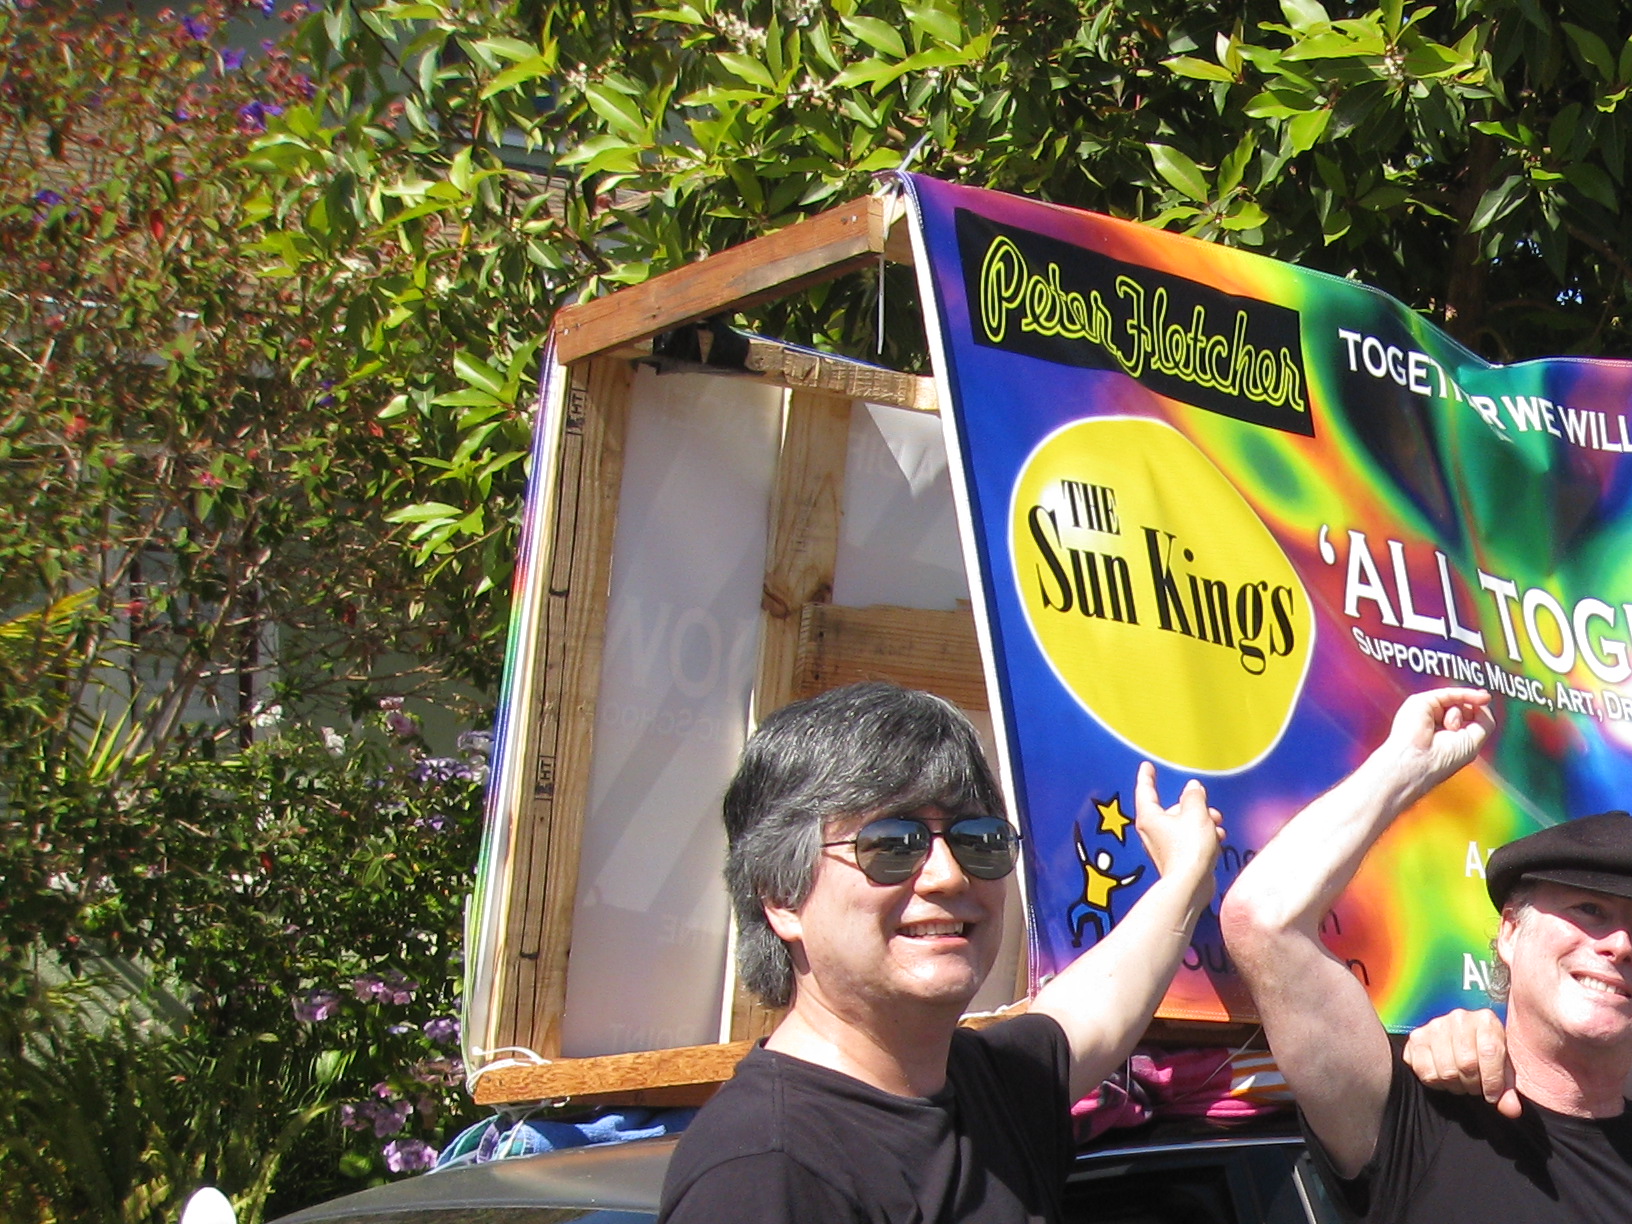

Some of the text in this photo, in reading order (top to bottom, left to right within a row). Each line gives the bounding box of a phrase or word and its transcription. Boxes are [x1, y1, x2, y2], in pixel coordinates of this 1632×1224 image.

[980, 235, 1304, 413] Peter Fletcher
[1338, 327, 1508, 434] TOGETR
[1501, 396, 1562, 438] WE
[1061, 479, 1121, 536] THE
[1028, 505, 1295, 676] Sun Kings
[1352, 626, 1485, 687] SUPPORTING
[1485, 661, 1553, 711] MUSIC,
[1557, 687, 1603, 723] ART,
